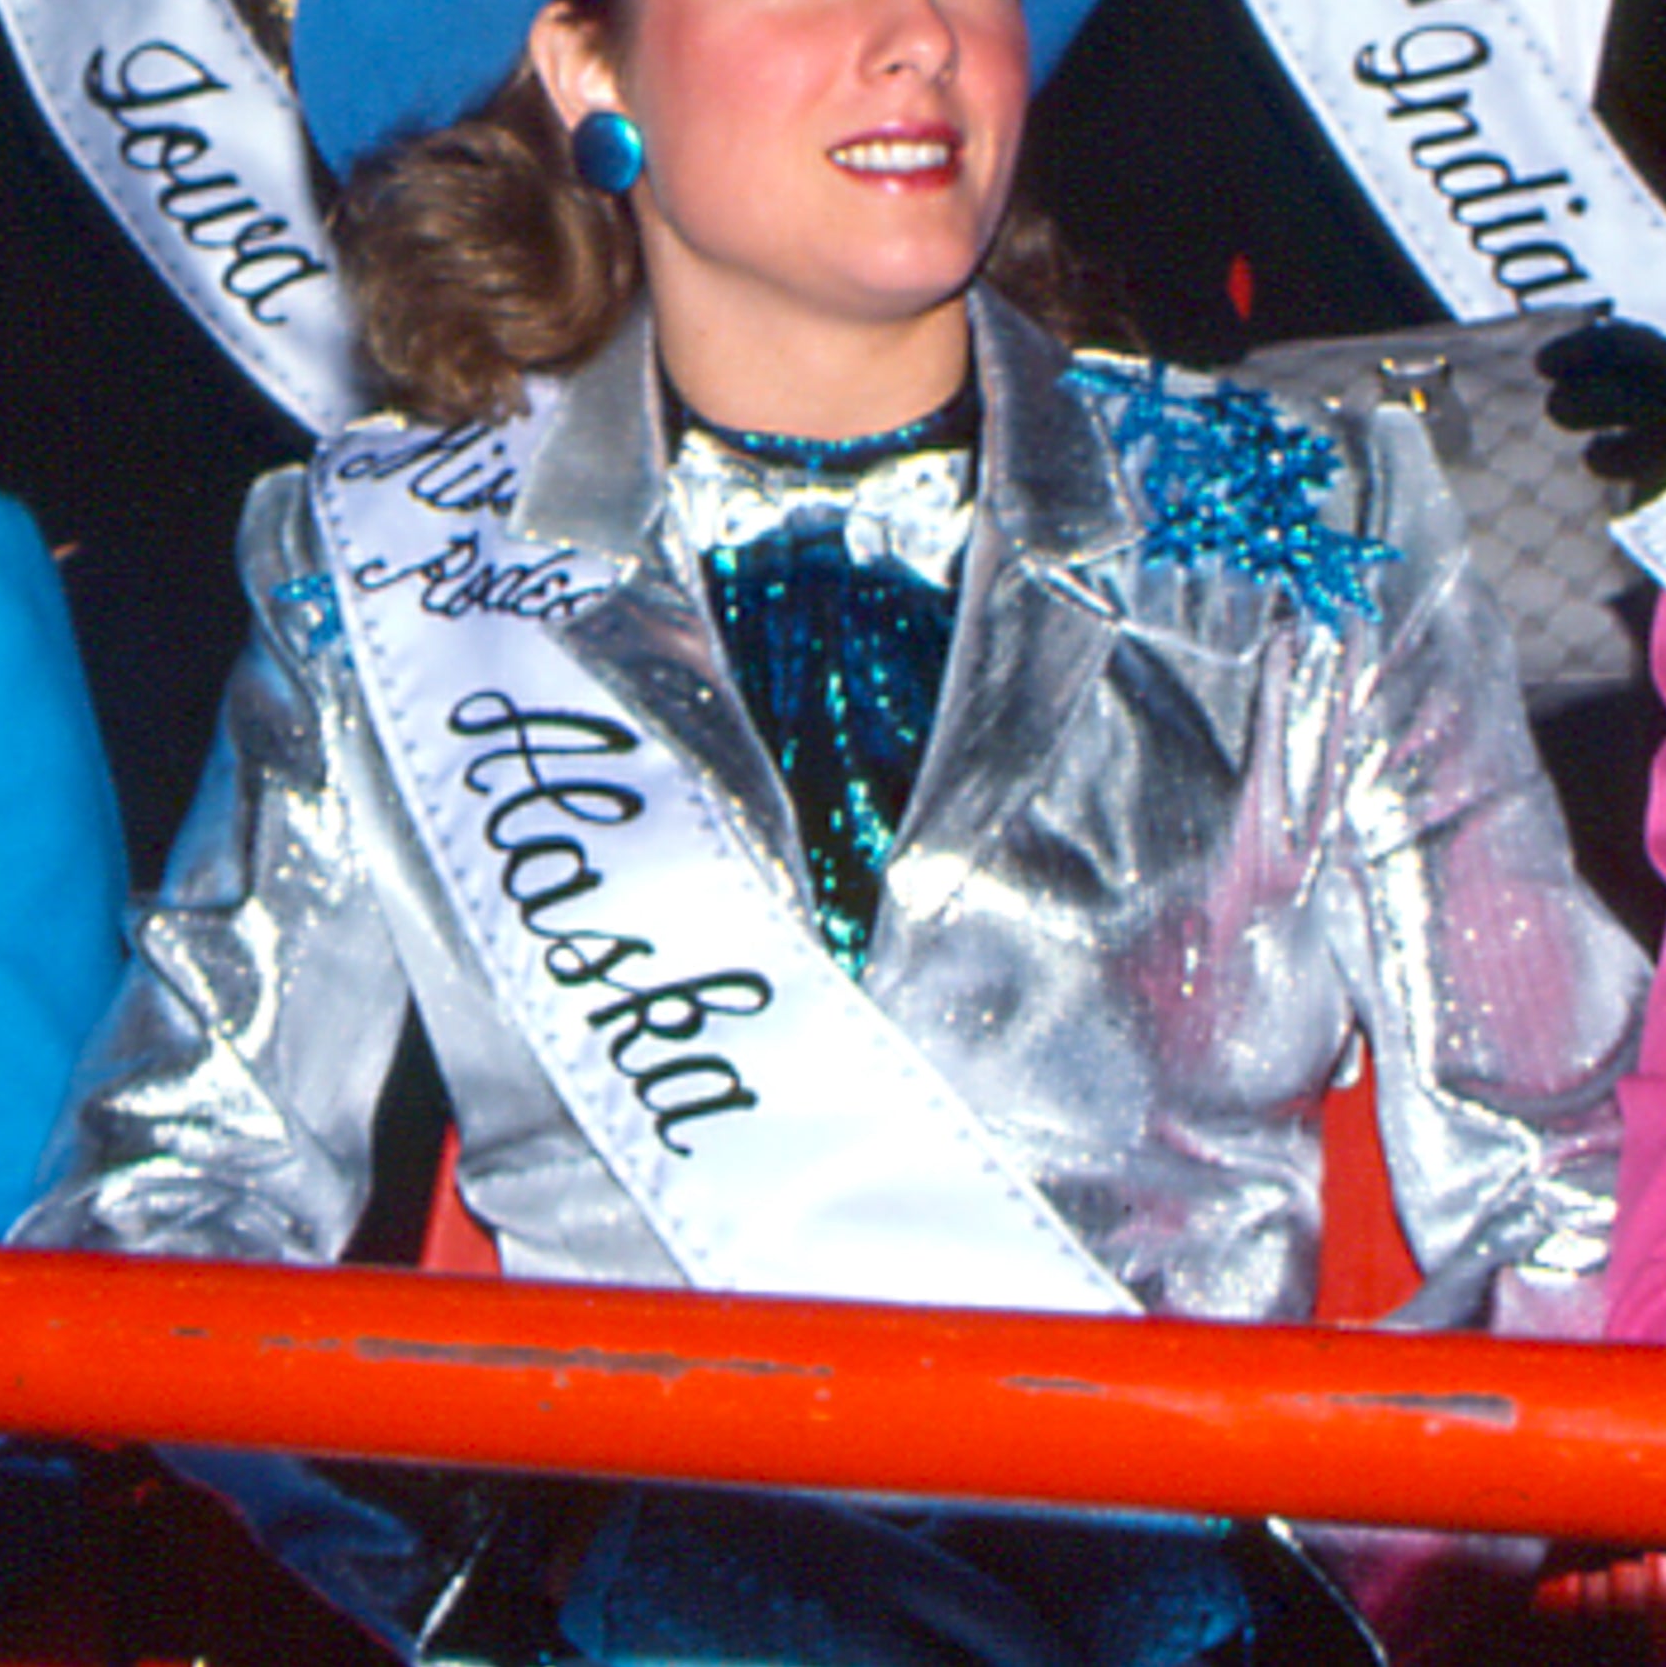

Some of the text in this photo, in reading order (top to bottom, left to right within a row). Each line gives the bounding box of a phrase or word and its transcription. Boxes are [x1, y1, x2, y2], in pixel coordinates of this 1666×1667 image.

[83, 40, 327, 327] Iowa
[1353, 23, 1614, 324] India
[447, 690, 774, 1159] Alaska
